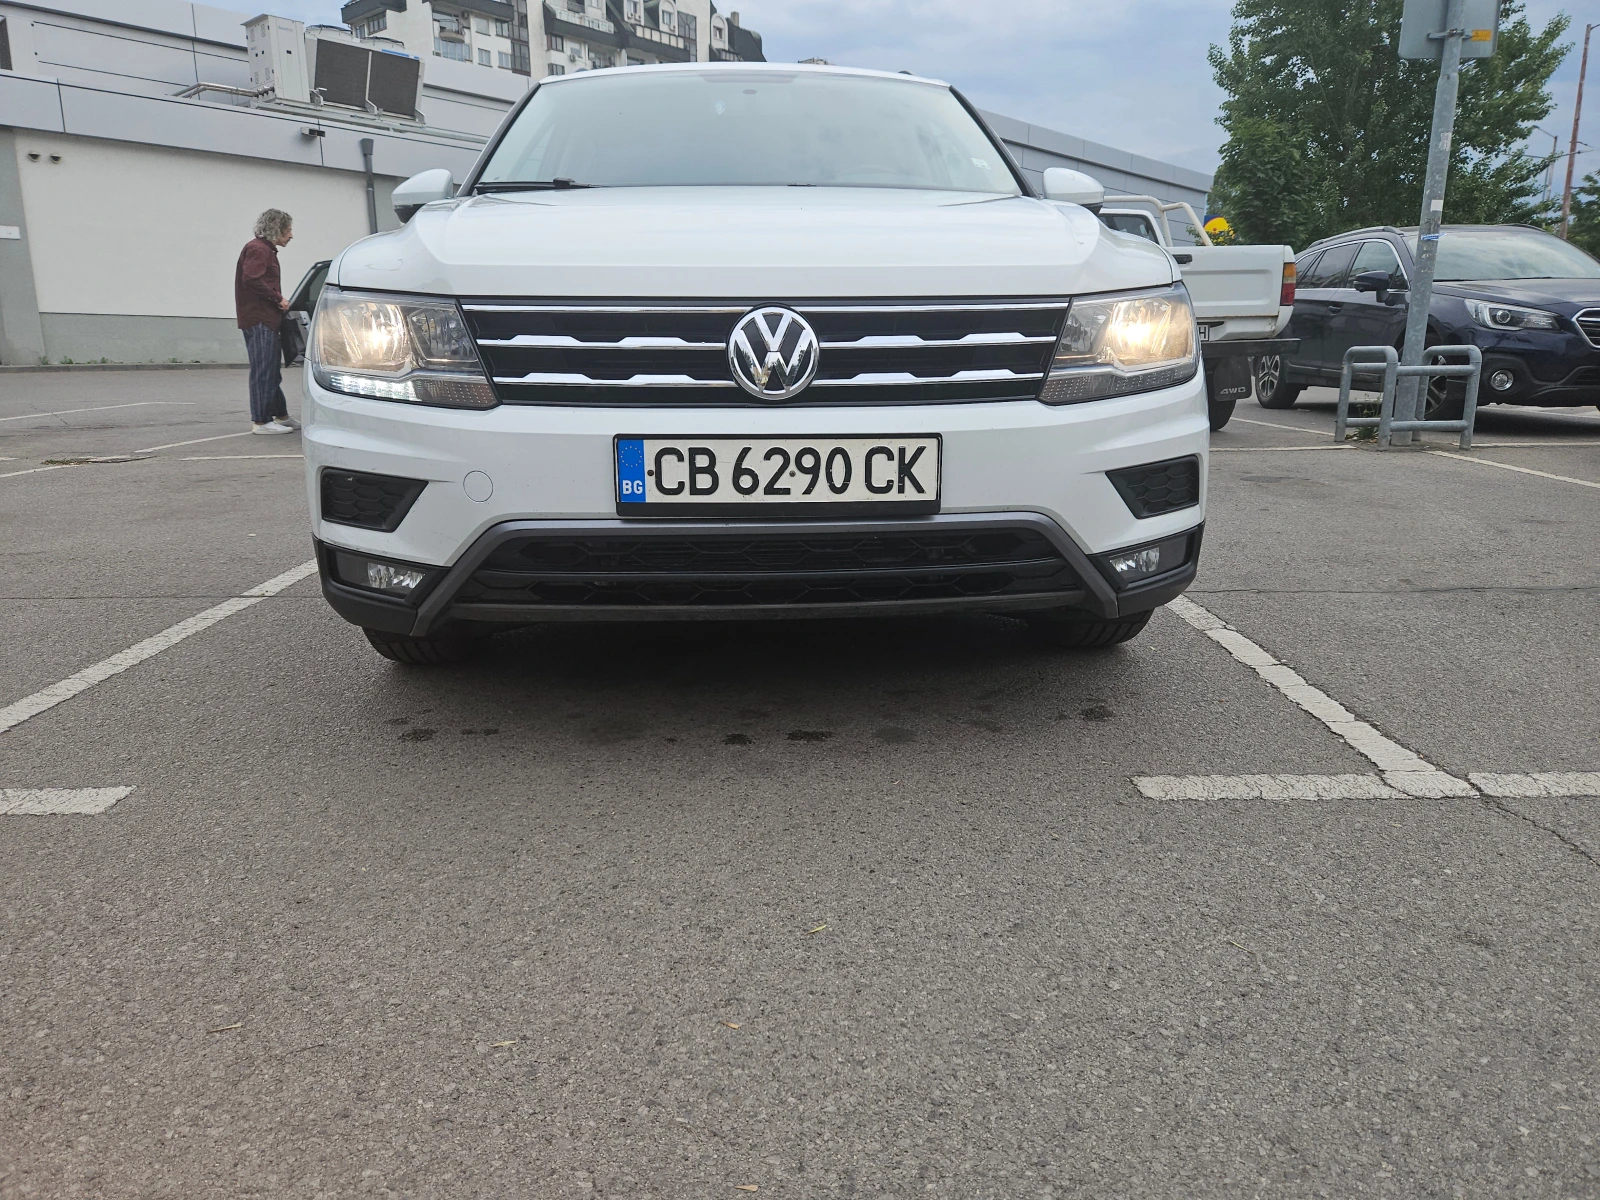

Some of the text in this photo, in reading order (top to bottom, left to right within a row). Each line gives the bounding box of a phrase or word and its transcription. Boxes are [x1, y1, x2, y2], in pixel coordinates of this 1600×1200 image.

[1220, 386, 1246, 395] 4WD
[654, 445, 927, 496] CB 6290 CK
[622, 480, 643, 495] BG
